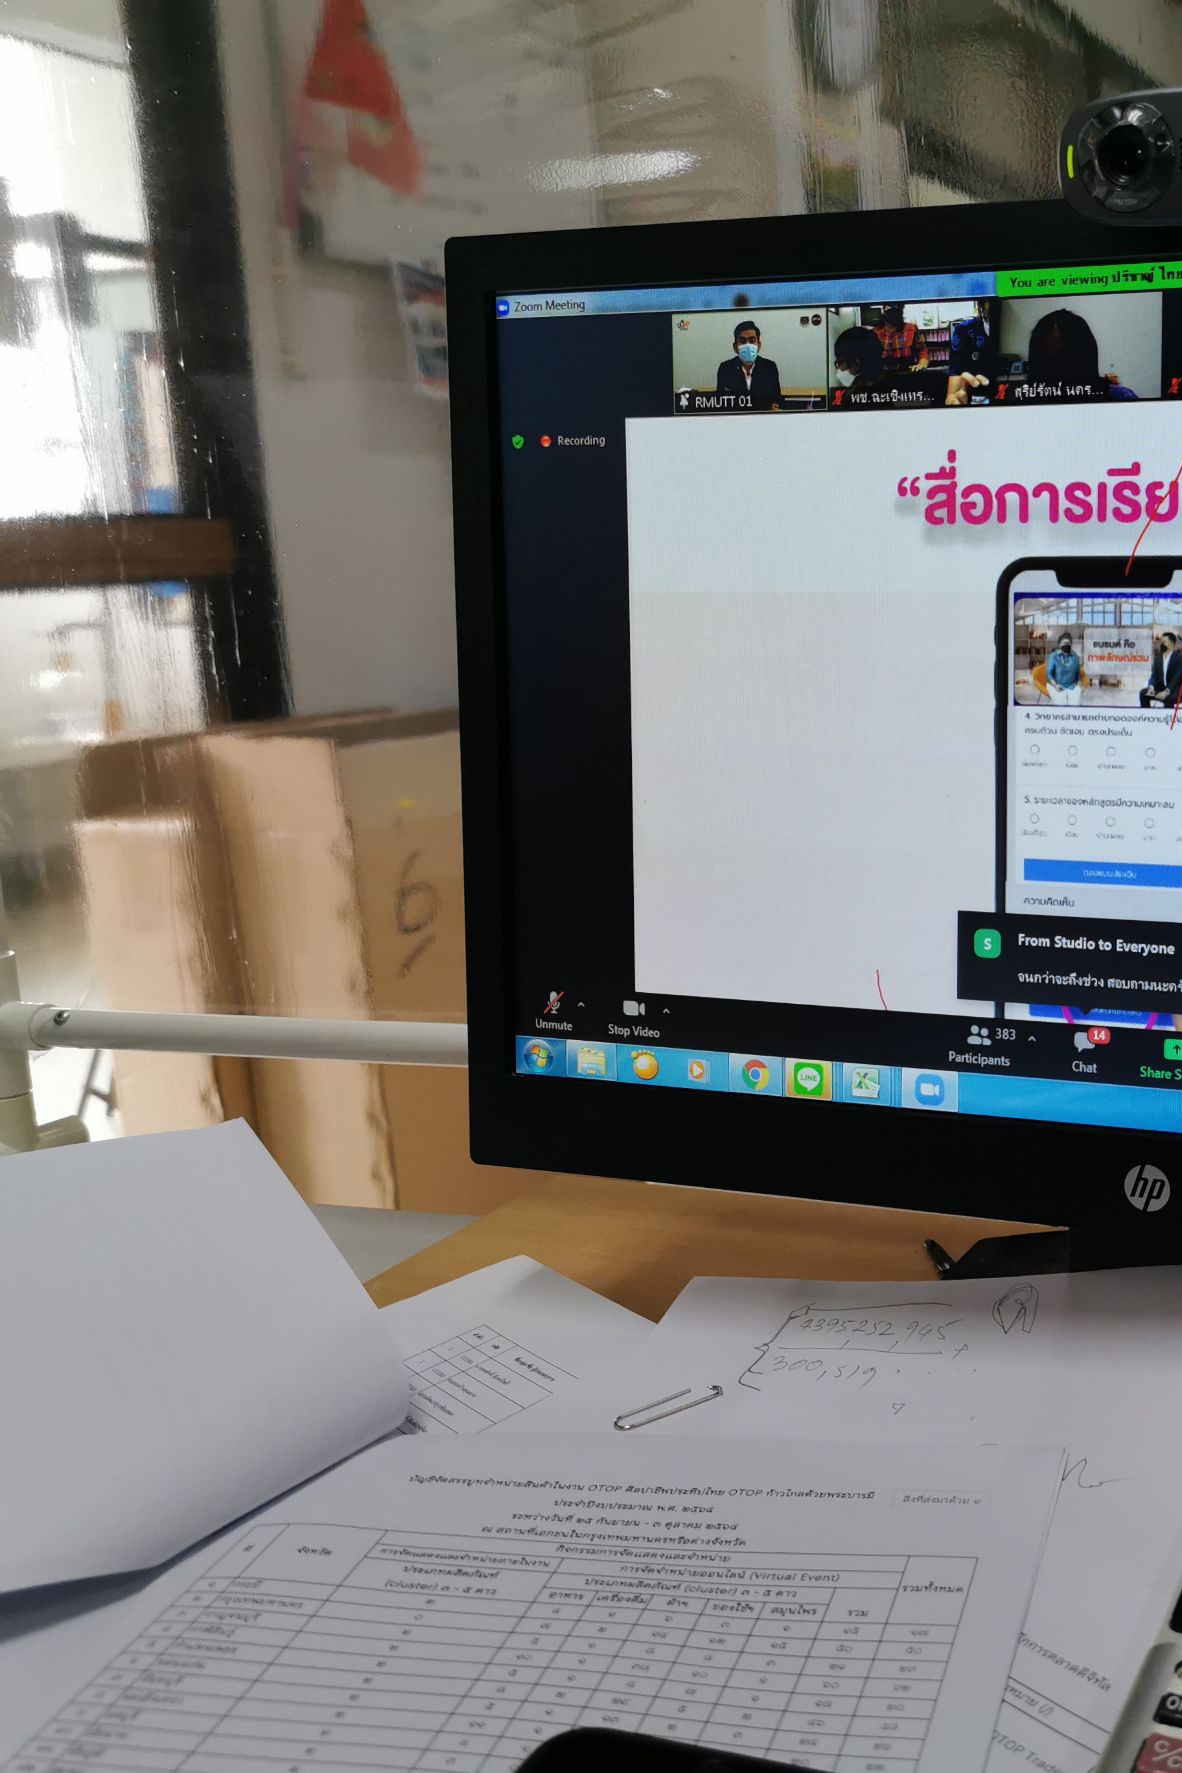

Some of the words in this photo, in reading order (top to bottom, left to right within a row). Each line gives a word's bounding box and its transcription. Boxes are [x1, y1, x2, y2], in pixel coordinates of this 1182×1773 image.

[1010, 276, 1032, 289] You
[1036, 277, 1056, 288] are
[1061, 272, 1109, 290] viewing
[514, 299, 543, 313] Zoom
[545, 298, 586, 314] Meeting
[695, 396, 737, 410] RMUTT
[739, 396, 753, 408] 01
[557, 433, 606, 449] Recording
[983, 938, 992, 951] S
[1017, 932, 1050, 948] From
[1053, 934, 1096, 951] Studio
[1097, 938, 1113, 951] to
[1116, 938, 1176, 957] Everyone
[1017, 969, 1105, 989] จนกว่าจะถึงช่วง
[535, 1017, 573, 1032] Unmute
[608, 1023, 631, 1039] Stop
[633, 1025, 661, 1039] Video
[994, 1026, 1017, 1041] 383
[1092, 1029, 1108, 1041] 14
[947, 1049, 1012, 1069] Participants
[1071, 1059, 1098, 1075] Chat
[1139, 1065, 1171, 1081] Share
[800, 1073, 818, 1082] LINE
[1128, 1164, 1165, 1212] hp
[588, 1483, 622, 1493] OTOP
[728, 1488, 764, 1497] OTOP
[554, 1498, 652, 1512] ประจำปีงบประมาณ
[656, 1504, 678, 1512] พ.ศ.
[511, 1511, 574, 1523] ระหว่างวันที่
[595, 1515, 641, 1528] กันยายน
[664, 1521, 703, 1532] ตุลาคม
[749, 1570, 798, 1583] (Virtual
[800, 1571, 841, 1584] Event)
[384, 1579, 438, 1593] (cluster)
[683, 1583, 738, 1596] (cluster)
[901, 1580, 965, 1594] รวมทั้งหมด
[770, 1603, 819, 1617] สมุนไพร
[846, 1608, 869, 1618] รวม
